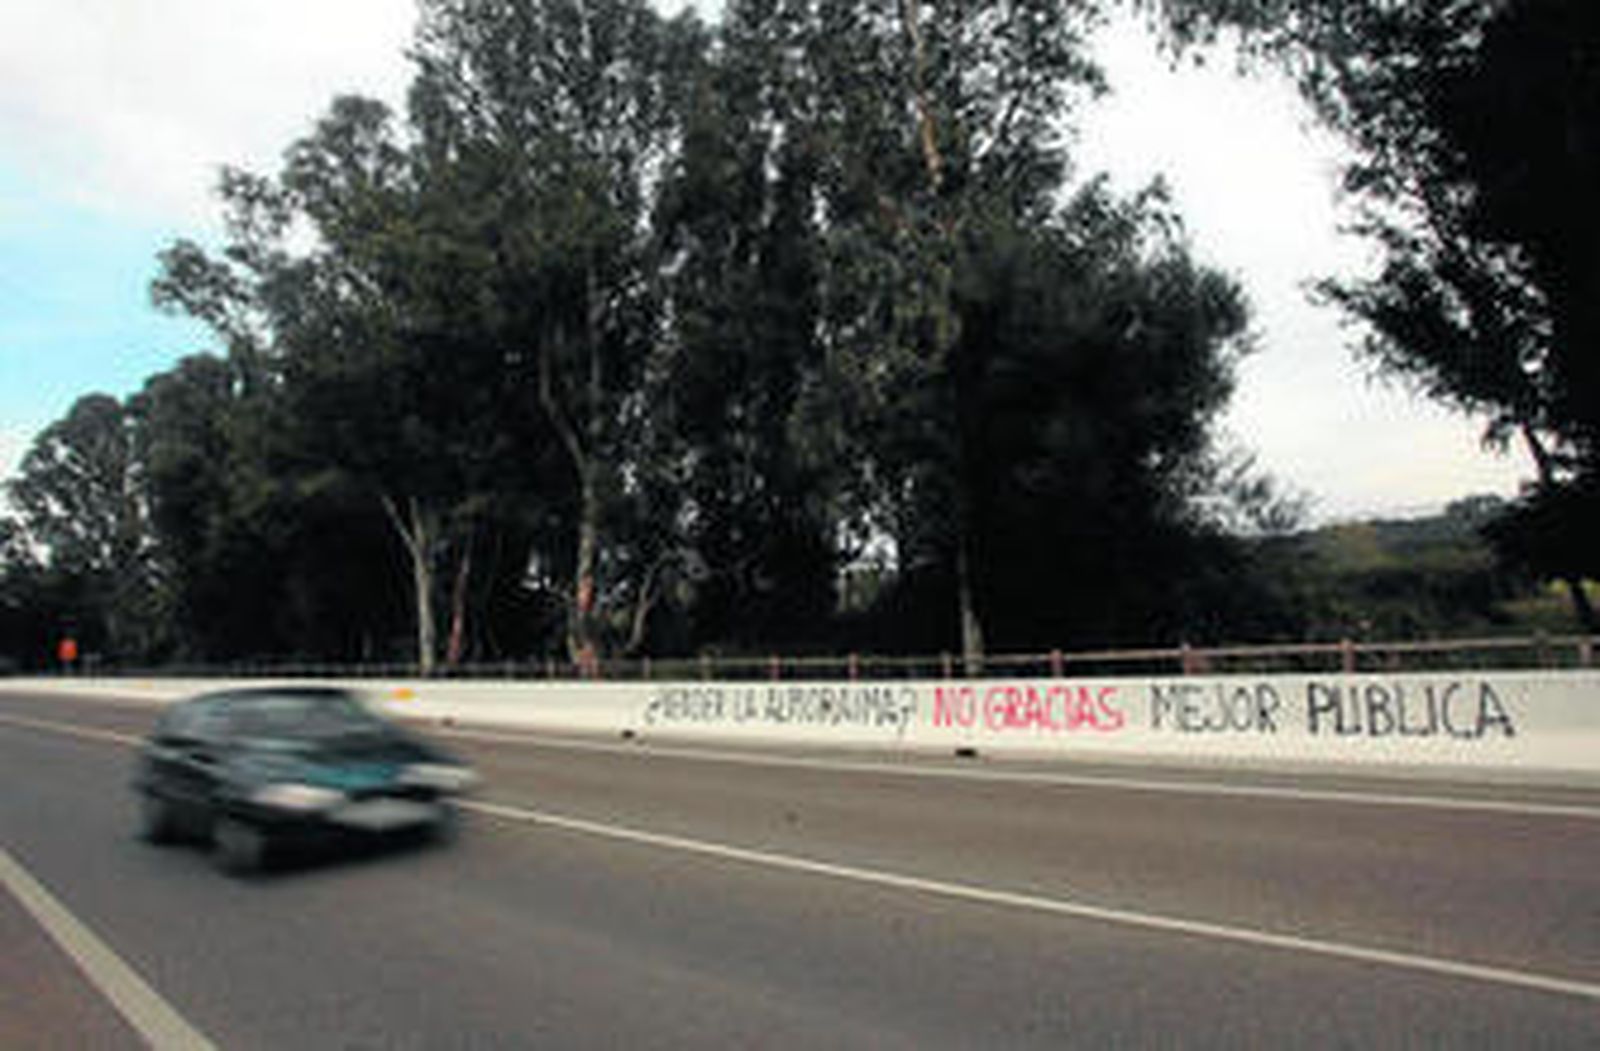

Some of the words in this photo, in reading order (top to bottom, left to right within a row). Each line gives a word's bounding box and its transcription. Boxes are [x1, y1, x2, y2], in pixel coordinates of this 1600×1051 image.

[733, 687, 757, 722] LA
[932, 686, 976, 729] NO
[982, 685, 1124, 732] GRACIAS
[1150, 684, 1280, 733] MEJOR
[1307, 681, 1515, 739] PUBLICA
